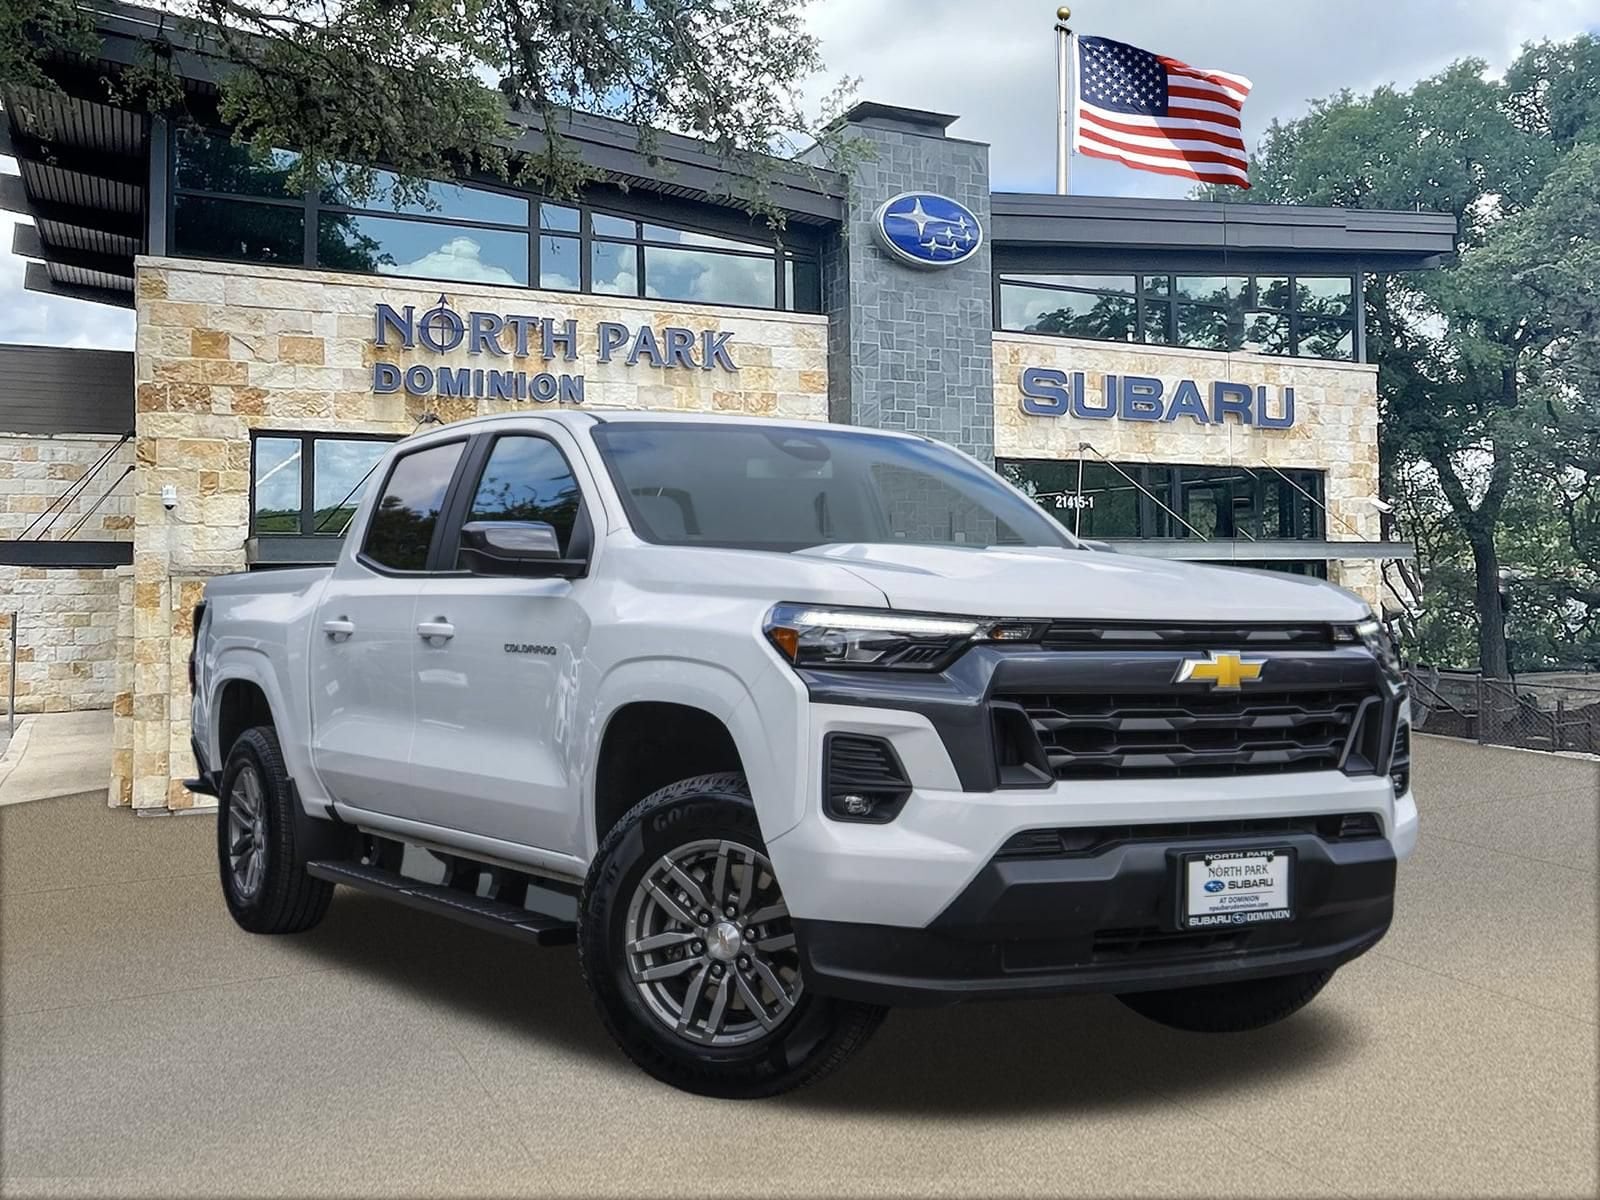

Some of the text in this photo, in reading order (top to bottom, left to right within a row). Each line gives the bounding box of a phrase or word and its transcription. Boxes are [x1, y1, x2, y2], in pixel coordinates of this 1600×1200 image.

[375, 302, 742, 373] NORTH PARK
[373, 362, 585, 403] DOMINION
[1019, 366, 1295, 430] SUBARU
[504, 643, 556, 655] COLORADO
[1205, 850, 1275, 861] NORTH PARK
[1208, 864, 1269, 878] NORTH PARK
[1228, 879, 1273, 889] SUBARU
[1189, 910, 1290, 926] SUBARU DOMINION
